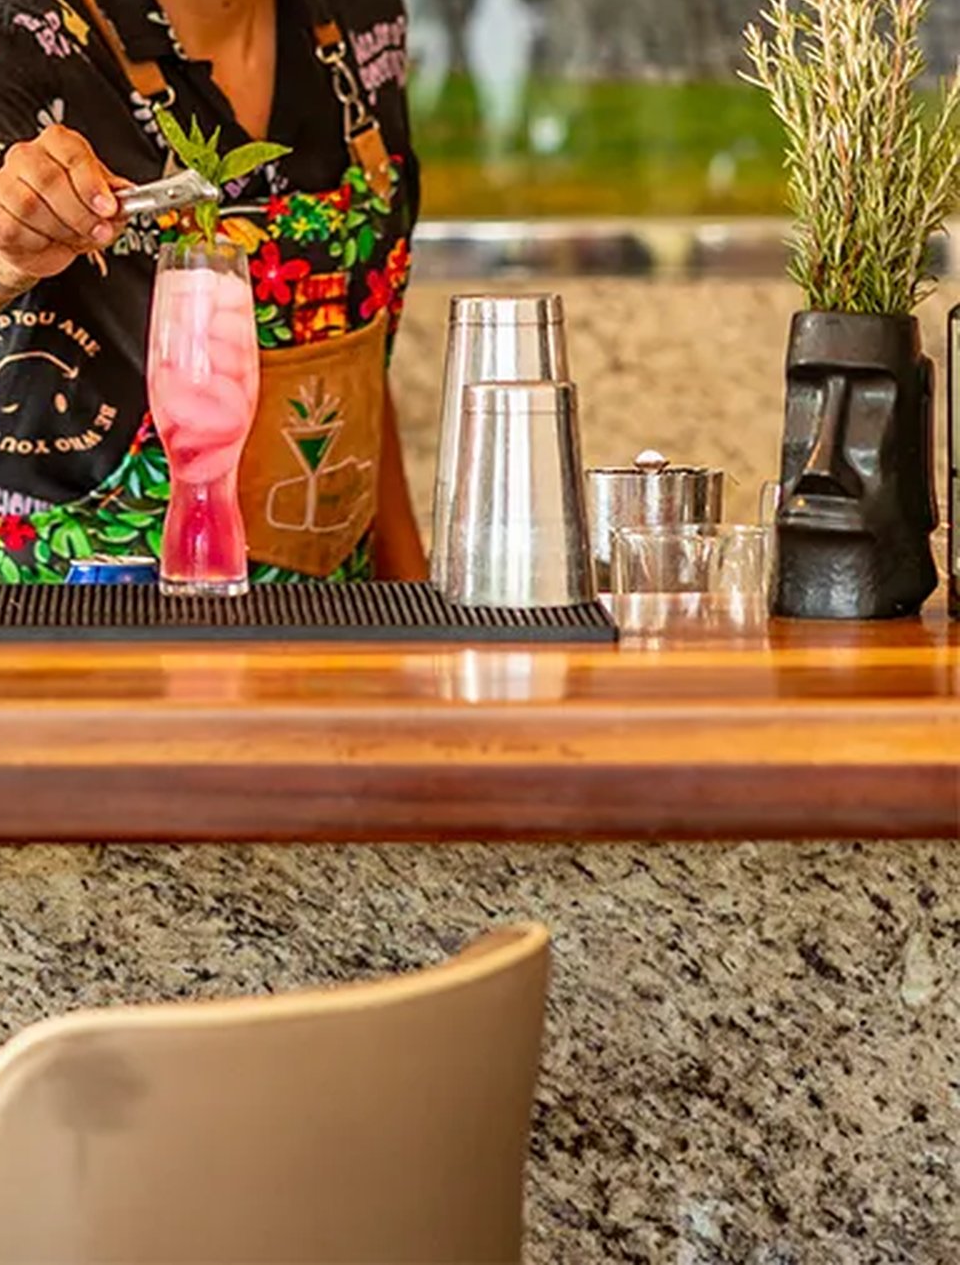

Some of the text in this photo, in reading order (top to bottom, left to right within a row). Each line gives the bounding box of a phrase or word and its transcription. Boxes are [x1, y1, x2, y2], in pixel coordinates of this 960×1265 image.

[13, 310, 55, 326] YOU
[59, 320, 100, 357] ARE
[0, 437, 49, 453] YOU
[55, 430, 102, 451] WHO
